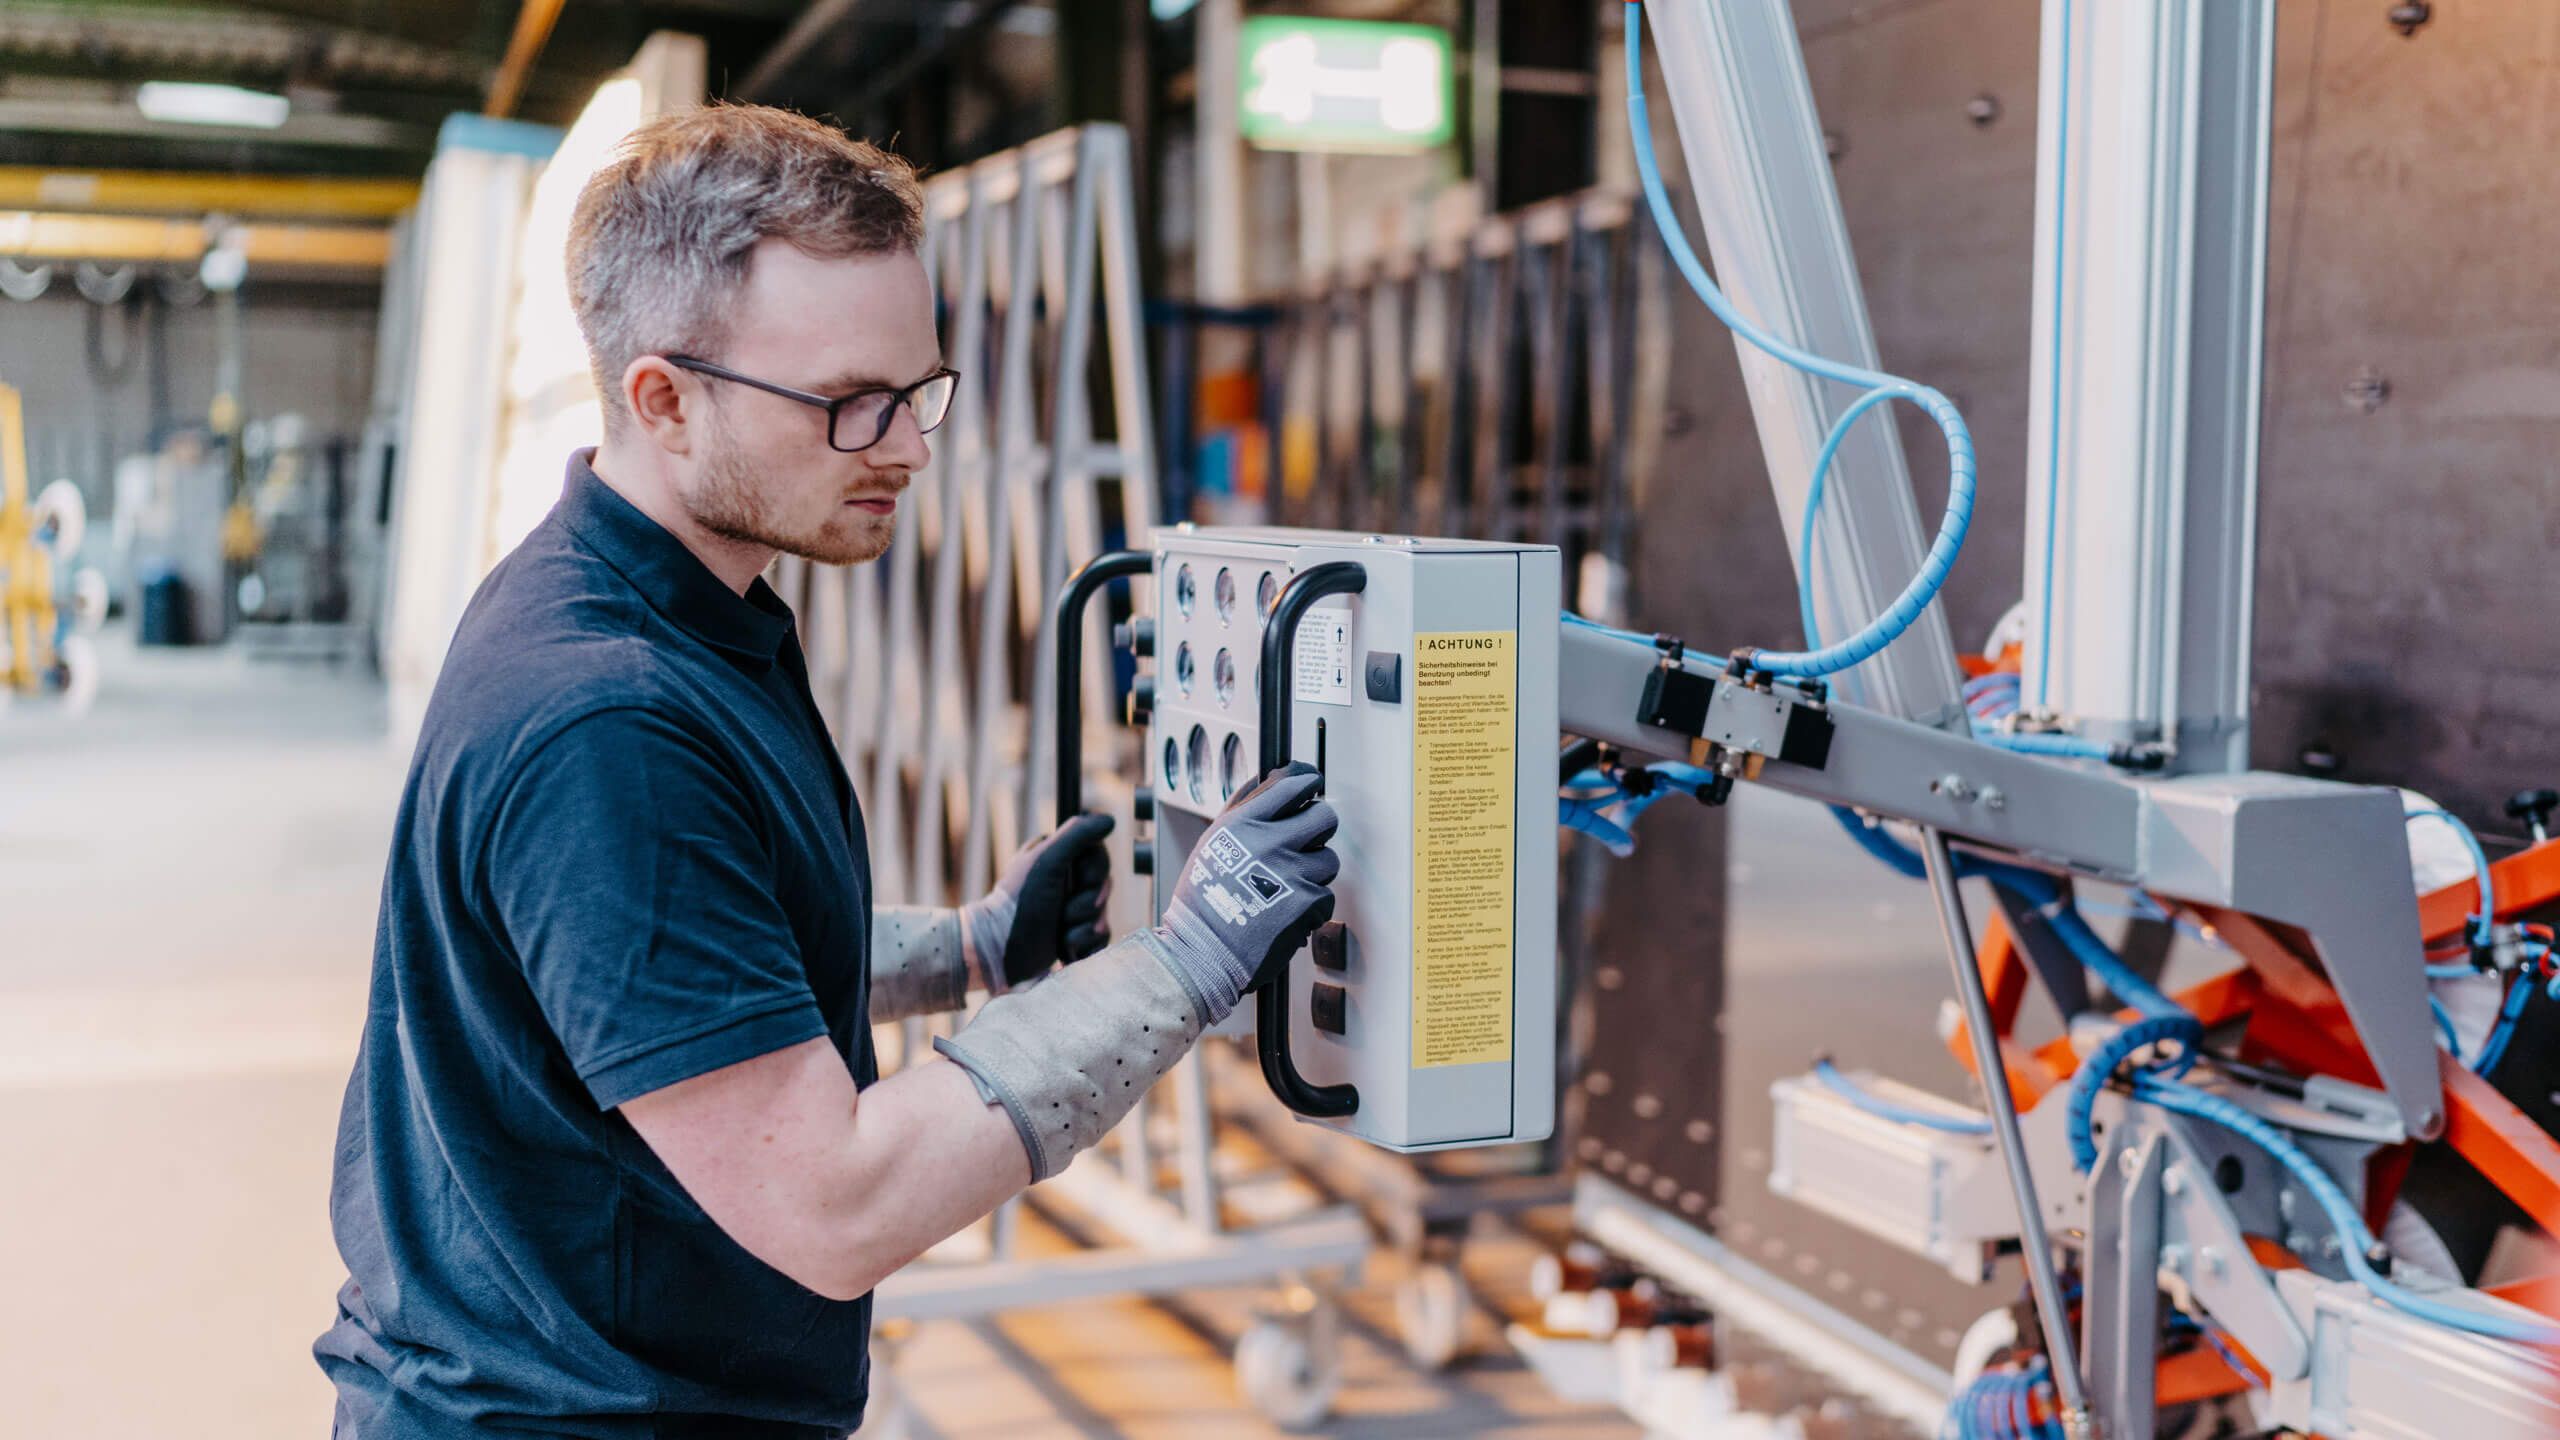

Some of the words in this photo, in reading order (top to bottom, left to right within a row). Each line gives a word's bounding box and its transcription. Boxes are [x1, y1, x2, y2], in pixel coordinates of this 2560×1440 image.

[1428, 638, 1493, 650] ACHTUNG
[1418, 661, 1486, 669] Sicherheitshinweise
[1488, 660, 1498, 668] bei
[1418, 670, 1455, 678] Benutzung
[1456, 670, 1491, 678] unbedingt
[1218, 834, 1241, 858] PRO
